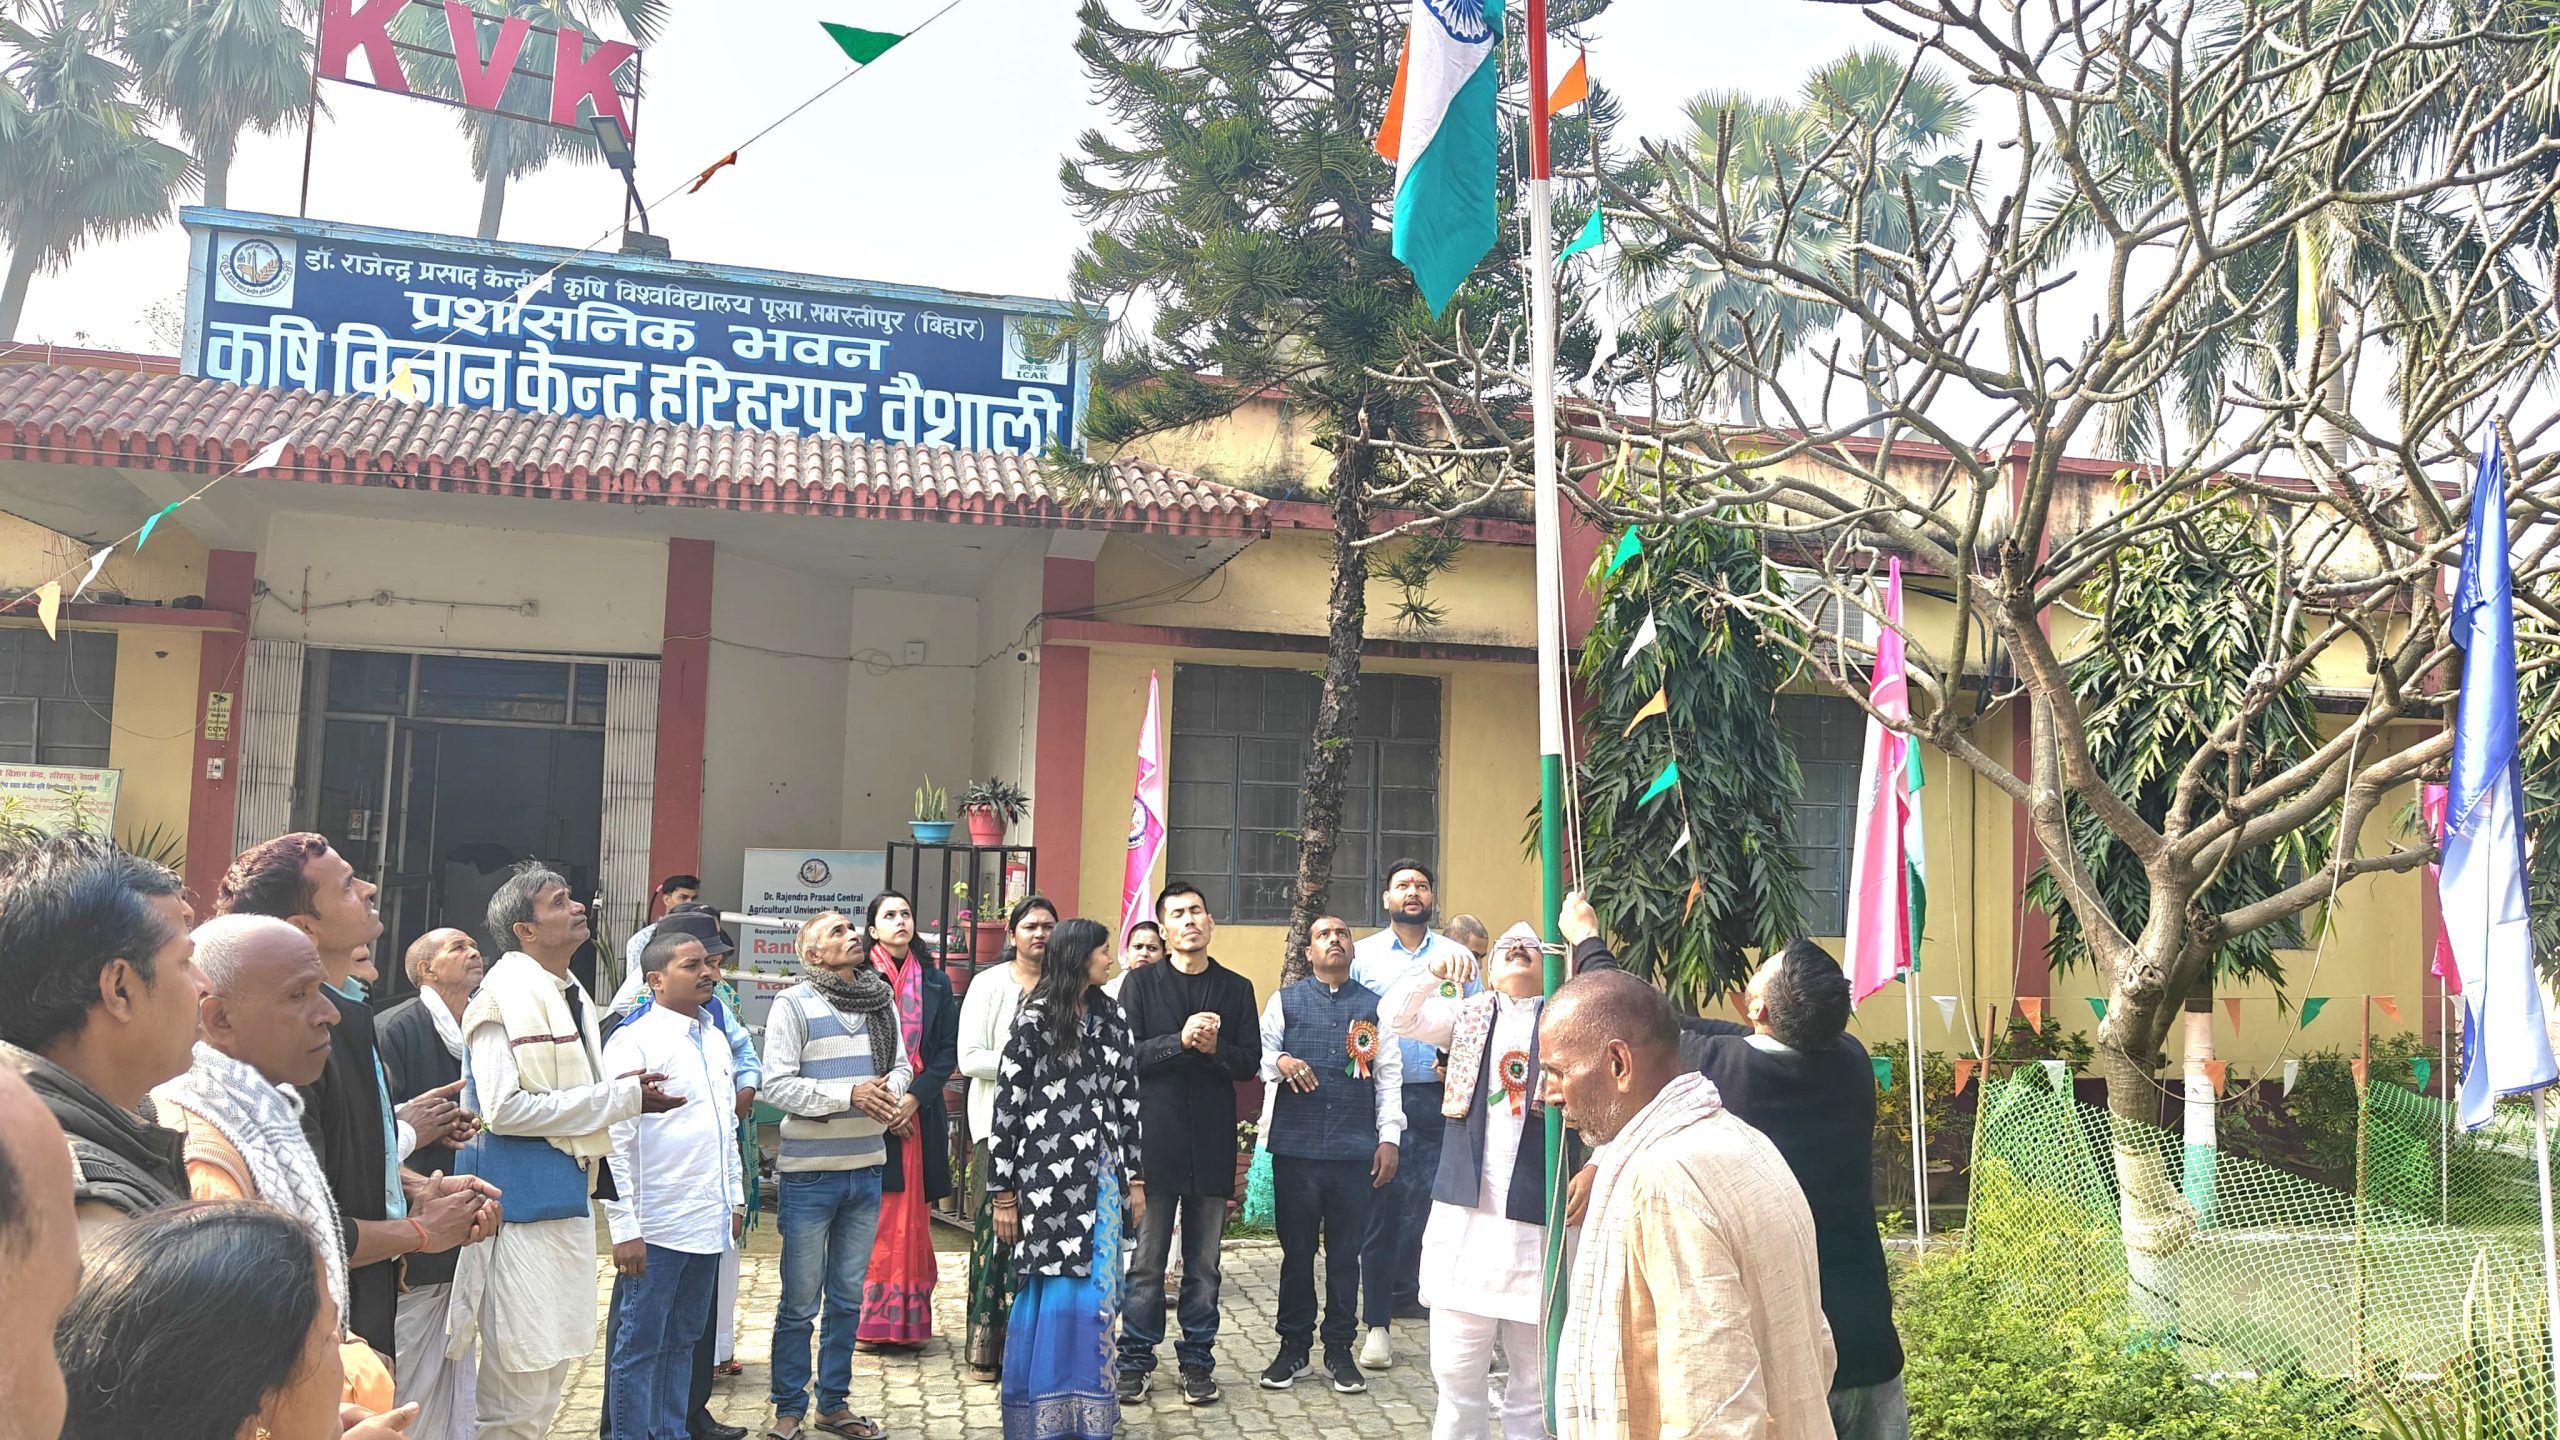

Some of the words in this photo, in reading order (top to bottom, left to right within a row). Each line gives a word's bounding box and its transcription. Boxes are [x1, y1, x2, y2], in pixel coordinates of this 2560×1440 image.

[319, 0, 639, 142] KVK
[341, 252, 414, 285] राजेन्द्र
[418, 261, 479, 291] प्रसाद
[564, 275, 609, 302] कृषि
[615, 278, 754, 315] विश्वविद्यालय
[915, 310, 984, 342] (बिहार)
[404, 291, 696, 352] प्रशासनिक
[728, 325, 891, 371] भवन
[206, 314, 325, 394] कषि
[879, 371, 1063, 457] वैशाली
[1016, 371, 1048, 380] ICAR
[749, 905, 792, 915] Agricultural
[764, 892, 774, 901] Dr.
[776, 892, 808, 903] Rajendra
[810, 893, 835, 902] Prasad
[837, 893, 863, 902] Central
